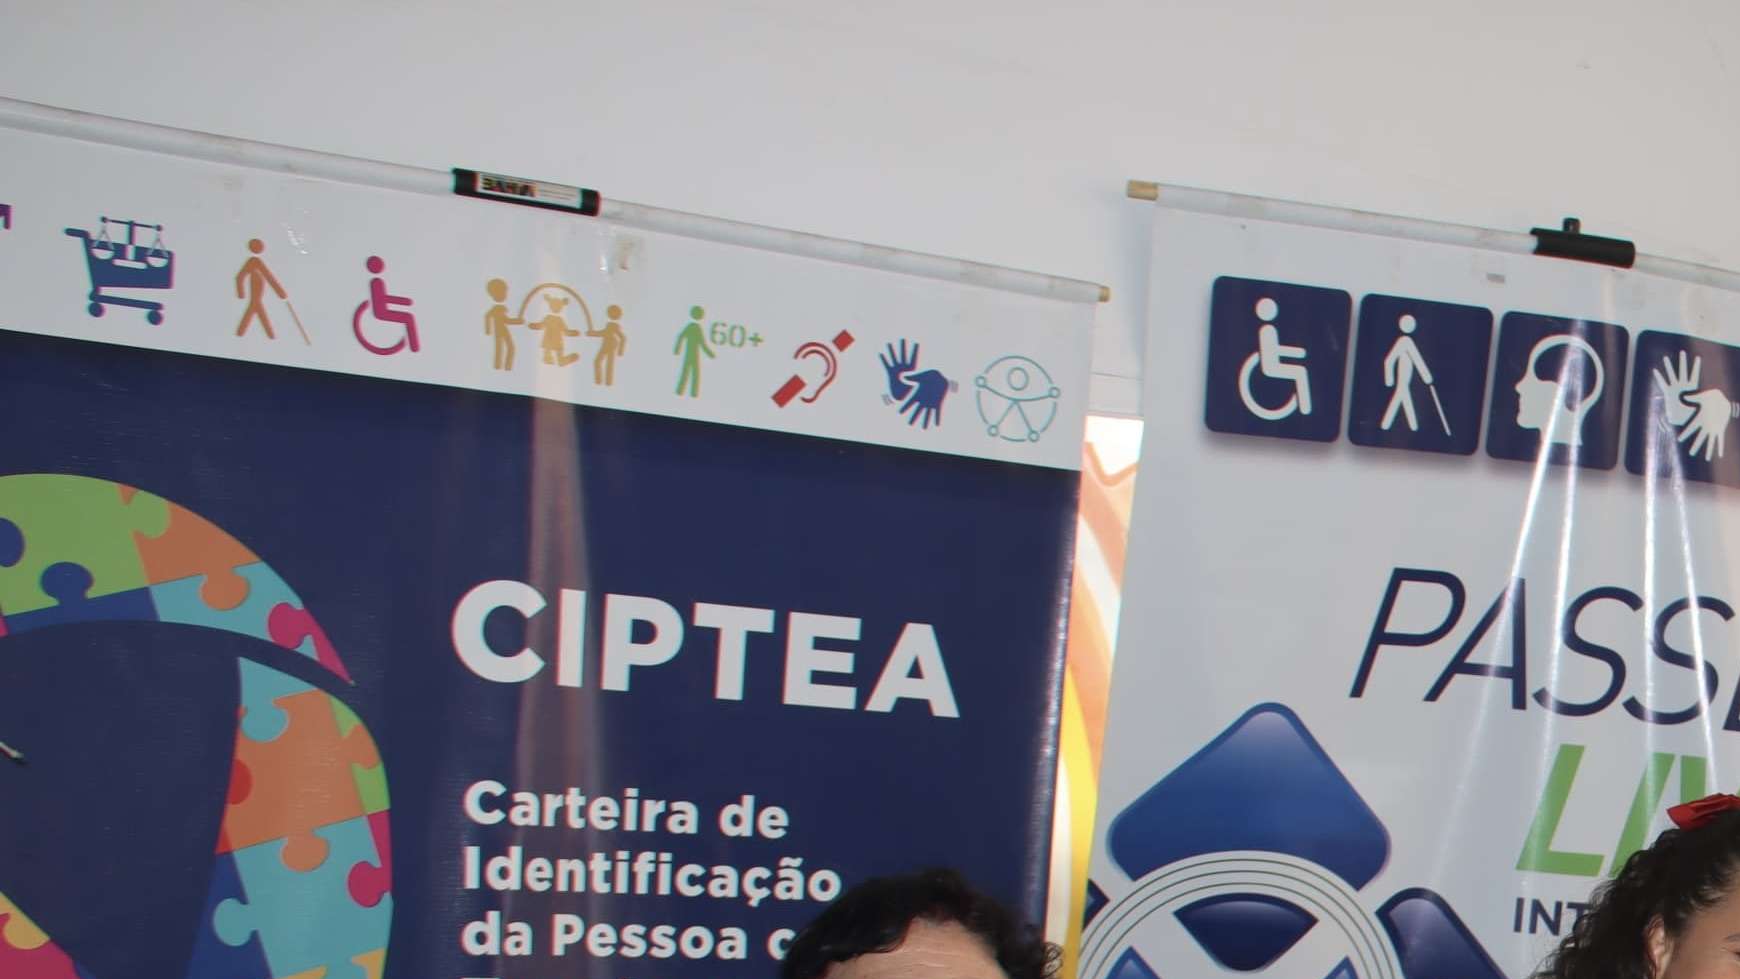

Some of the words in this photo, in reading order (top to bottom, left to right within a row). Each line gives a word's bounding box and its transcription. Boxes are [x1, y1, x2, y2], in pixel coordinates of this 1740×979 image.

[710, 320, 764, 349] 60+
[451, 580, 960, 719] CIPTEA
[463, 779, 699, 834] Carteira
[719, 795, 789, 838] de
[463, 845, 842, 907] Identificação
[461, 911, 533, 956] da
[551, 914, 747, 960] Pessoa
